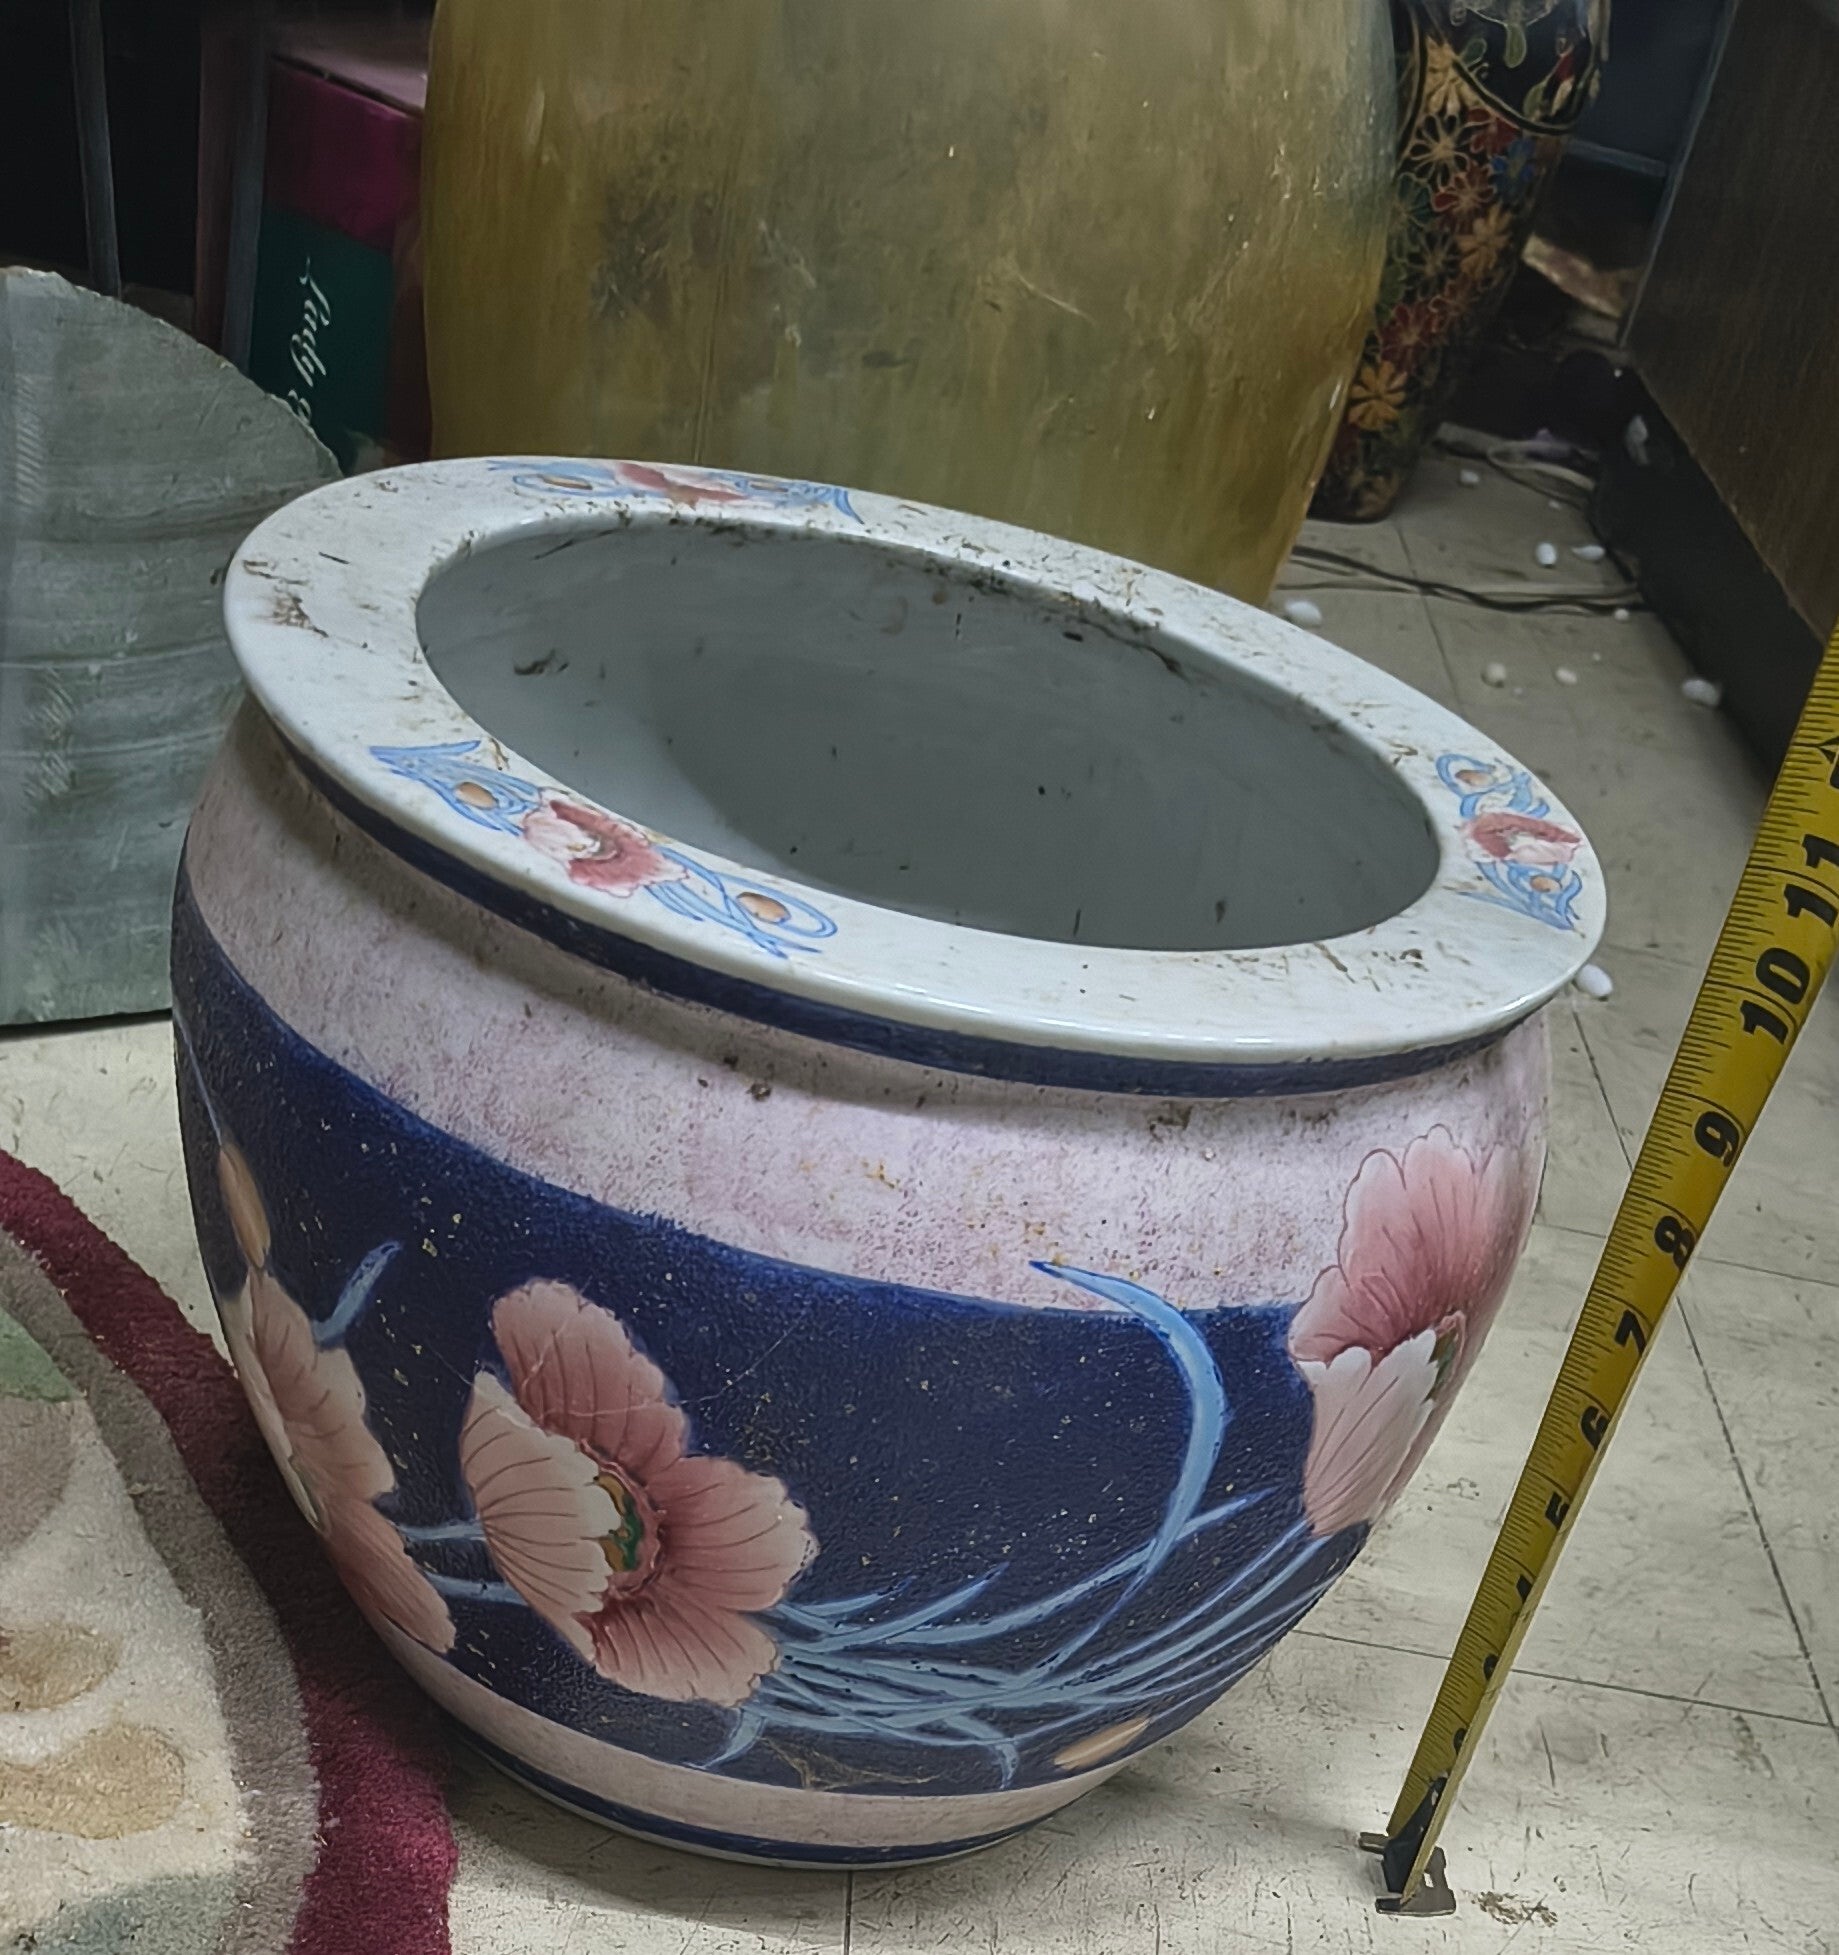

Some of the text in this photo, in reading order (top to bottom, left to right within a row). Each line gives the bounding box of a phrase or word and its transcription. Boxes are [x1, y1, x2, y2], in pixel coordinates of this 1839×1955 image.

[290, 255, 331, 387] Lady
[1783, 834, 1839, 928] 11
[1740, 947, 1810, 1044] 10
[1694, 1110, 1740, 1167] 9
[1654, 1215, 1696, 1271] 8
[1615, 1310, 1647, 1357] 7
